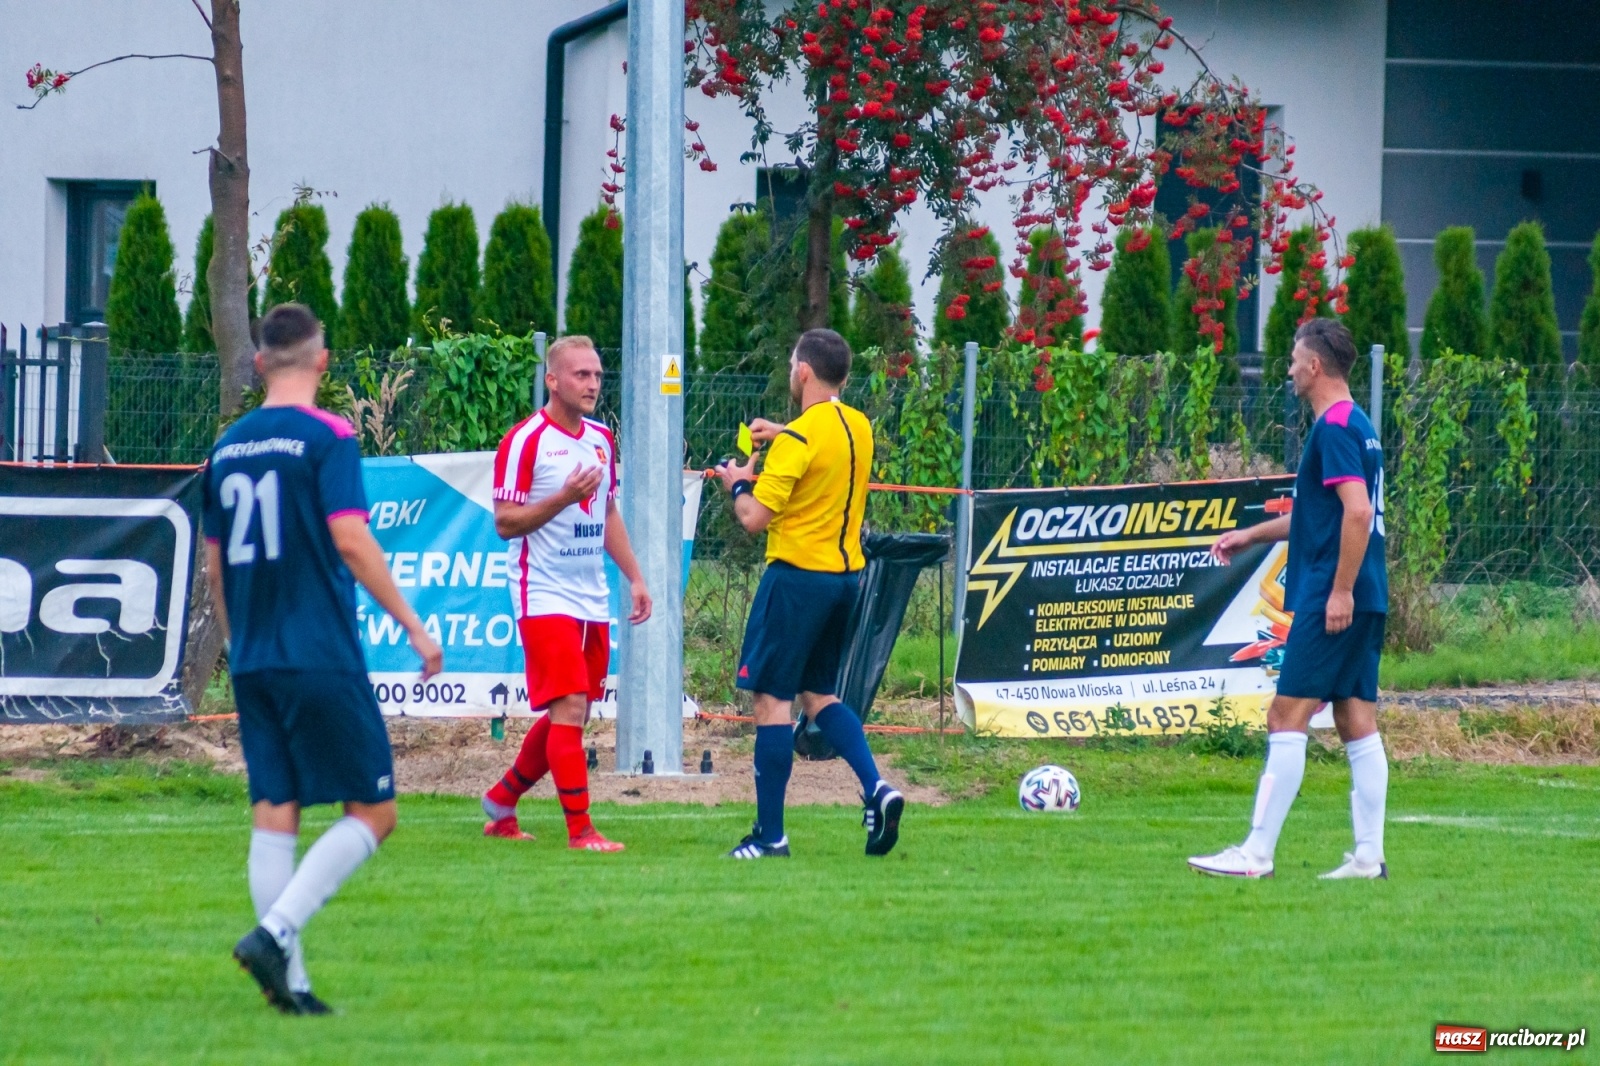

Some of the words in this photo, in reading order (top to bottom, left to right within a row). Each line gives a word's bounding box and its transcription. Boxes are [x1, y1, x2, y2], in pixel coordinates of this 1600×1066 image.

[219, 470, 279, 565] 21
[1016, 497, 1238, 540] OCZKOINSTAL
[559, 547, 594, 556] GALERIA
[383, 551, 509, 588] ERNE
[1031, 556, 1121, 577] INSTALACJE
[1124, 551, 1226, 571] ELEKTRYCZN
[1075, 577, 1124, 594] ŁUKASZ
[1126, 573, 1184, 590] OCZADŁY
[1037, 599, 1125, 617] KOMPLEKSOWE
[1127, 594, 1195, 610] INSTALACJE
[357, 604, 523, 648] WATŁO
[1035, 615, 1113, 633] ELEKTRYCZNE
[1115, 614, 1127, 628] W
[1129, 612, 1167, 626] DOMU
[1033, 635, 1097, 653] PRZYŁĄCZA
[1113, 632, 1162, 648] UZIOMY
[1032, 656, 1086, 672] POMIARY
[1101, 651, 1171, 668] DOMOFONY
[371, 683, 406, 704] 00
[412, 683, 466, 704] 9002
[996, 686, 1039, 701] 47-450
[1041, 685, 1076, 699] Nowa
[1077, 681, 1123, 696] Wioska
[1143, 678, 1158, 693] ul.
[1160, 677, 1197, 692] Leśna
[1200, 675, 1216, 689] 24
[1152, 704, 1200, 728] 852
